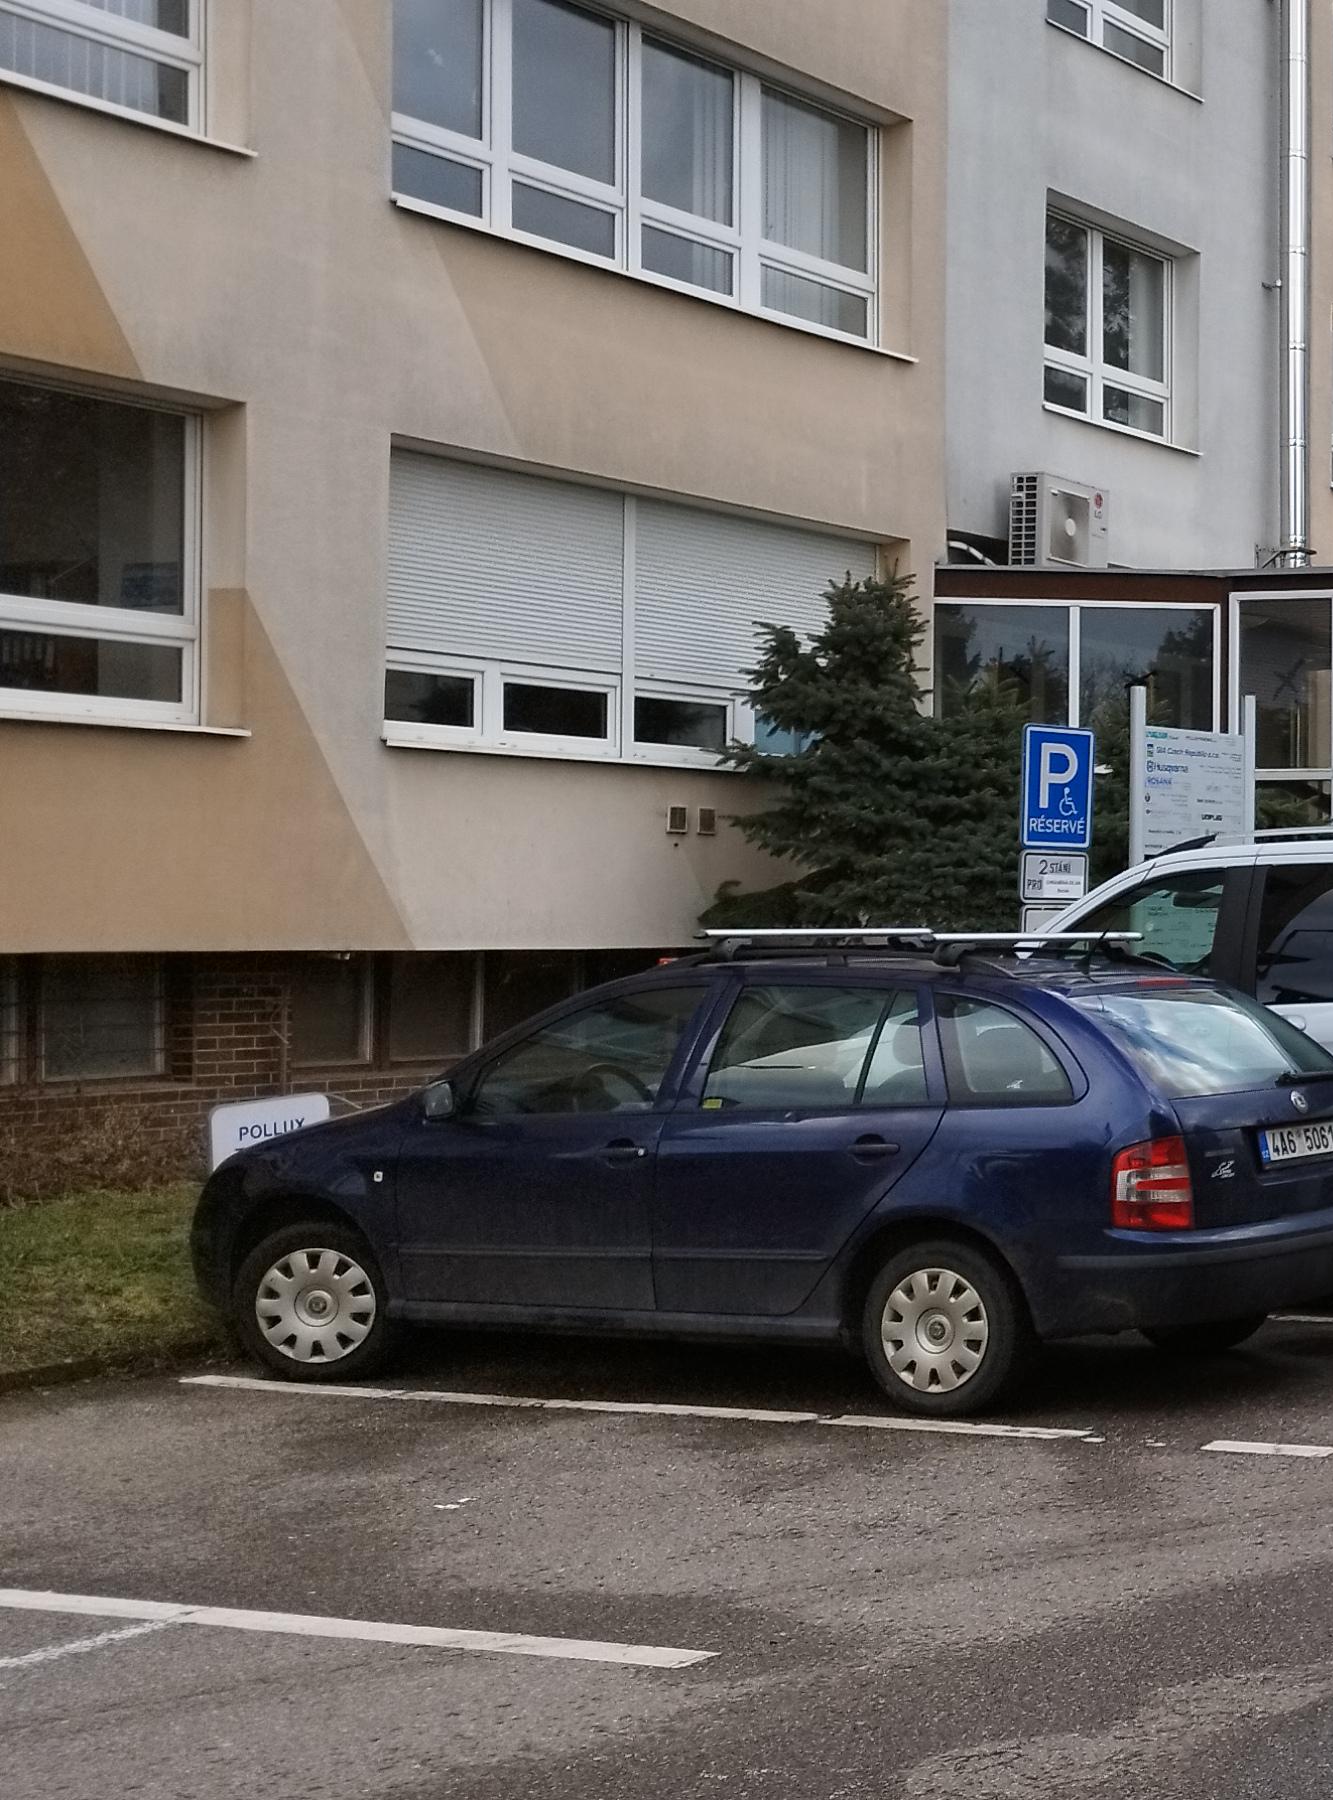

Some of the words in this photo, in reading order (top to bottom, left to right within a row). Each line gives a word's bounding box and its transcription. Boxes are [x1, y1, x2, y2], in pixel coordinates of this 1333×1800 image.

[1039, 742, 1079, 809] P
[1029, 815, 1086, 834] RÉSERVÉ
[1039, 859, 1048, 875] 2
[239, 1117, 305, 1141] POLLUX
[1270, 1130, 1297, 1156] 4A6
